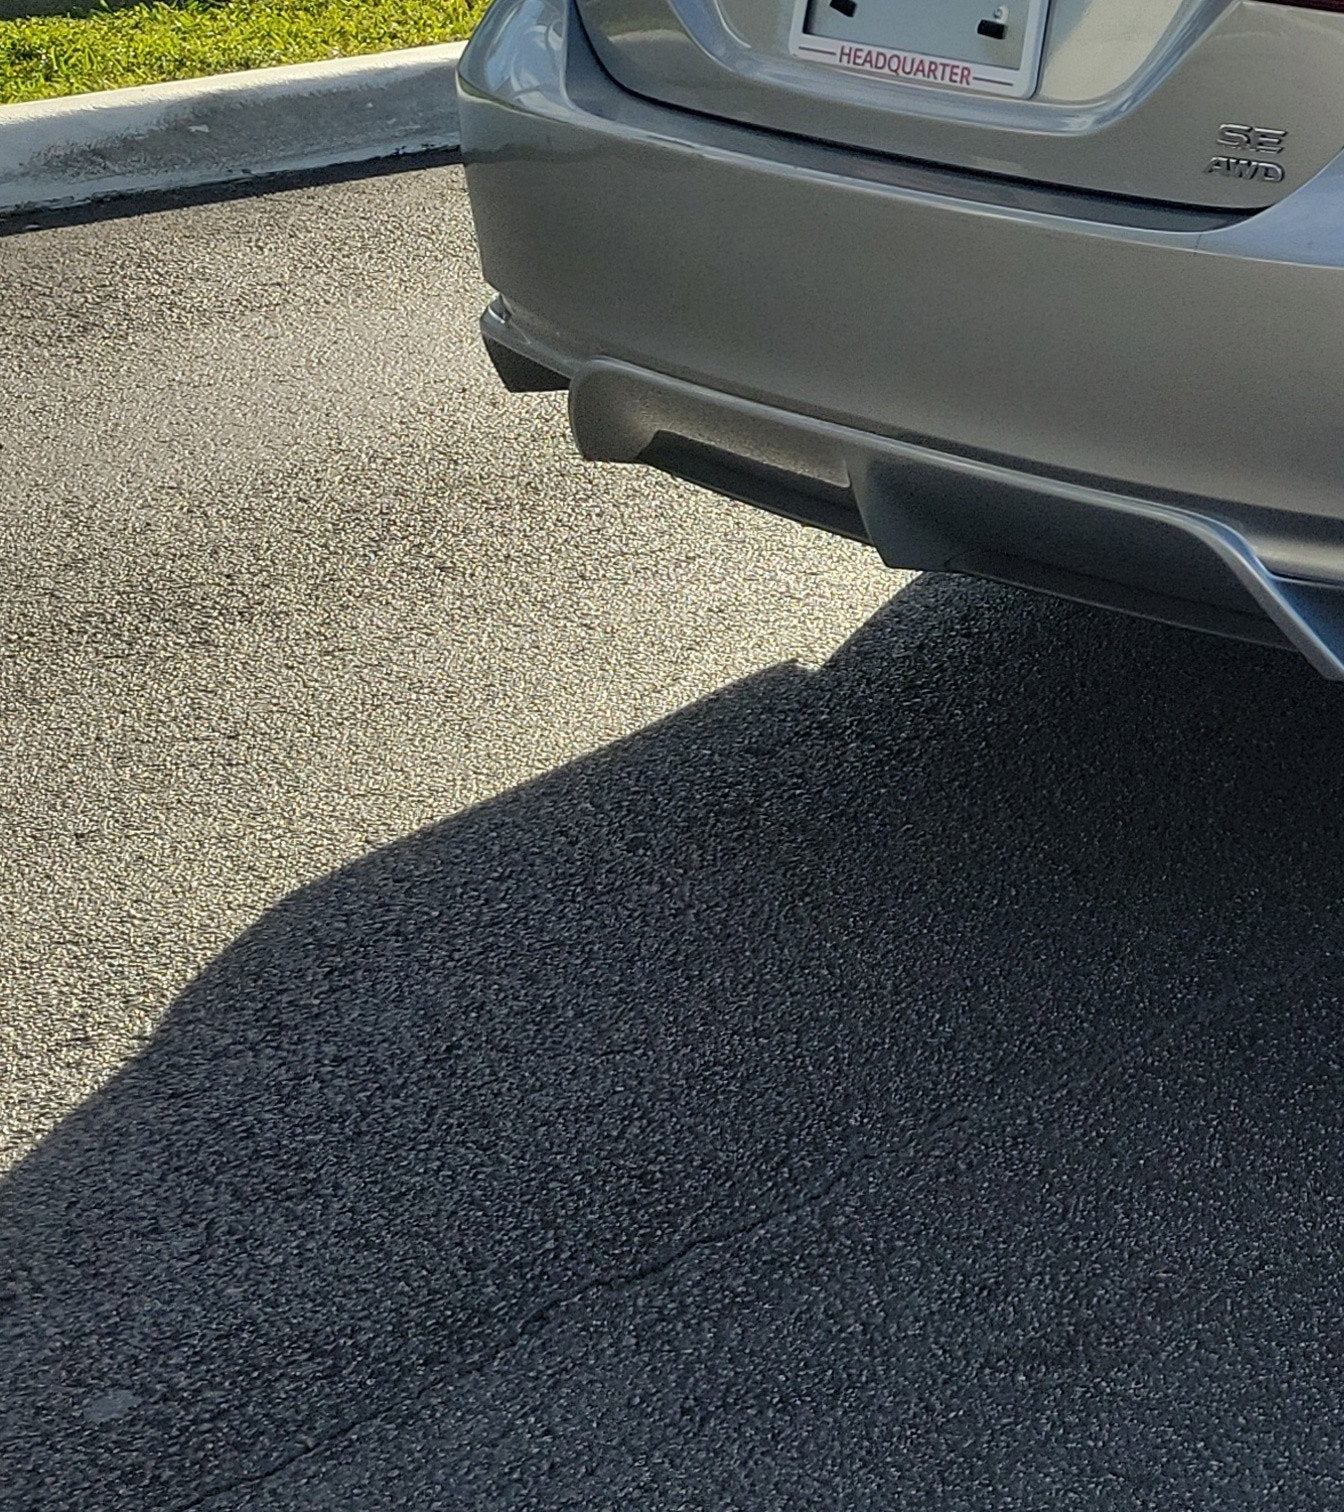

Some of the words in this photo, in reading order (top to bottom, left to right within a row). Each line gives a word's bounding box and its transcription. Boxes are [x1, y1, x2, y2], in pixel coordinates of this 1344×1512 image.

[838, 45, 971, 86] HEADQUARTER
[1217, 124, 1287, 154] SE
[1205, 156, 1285, 182] AWD
